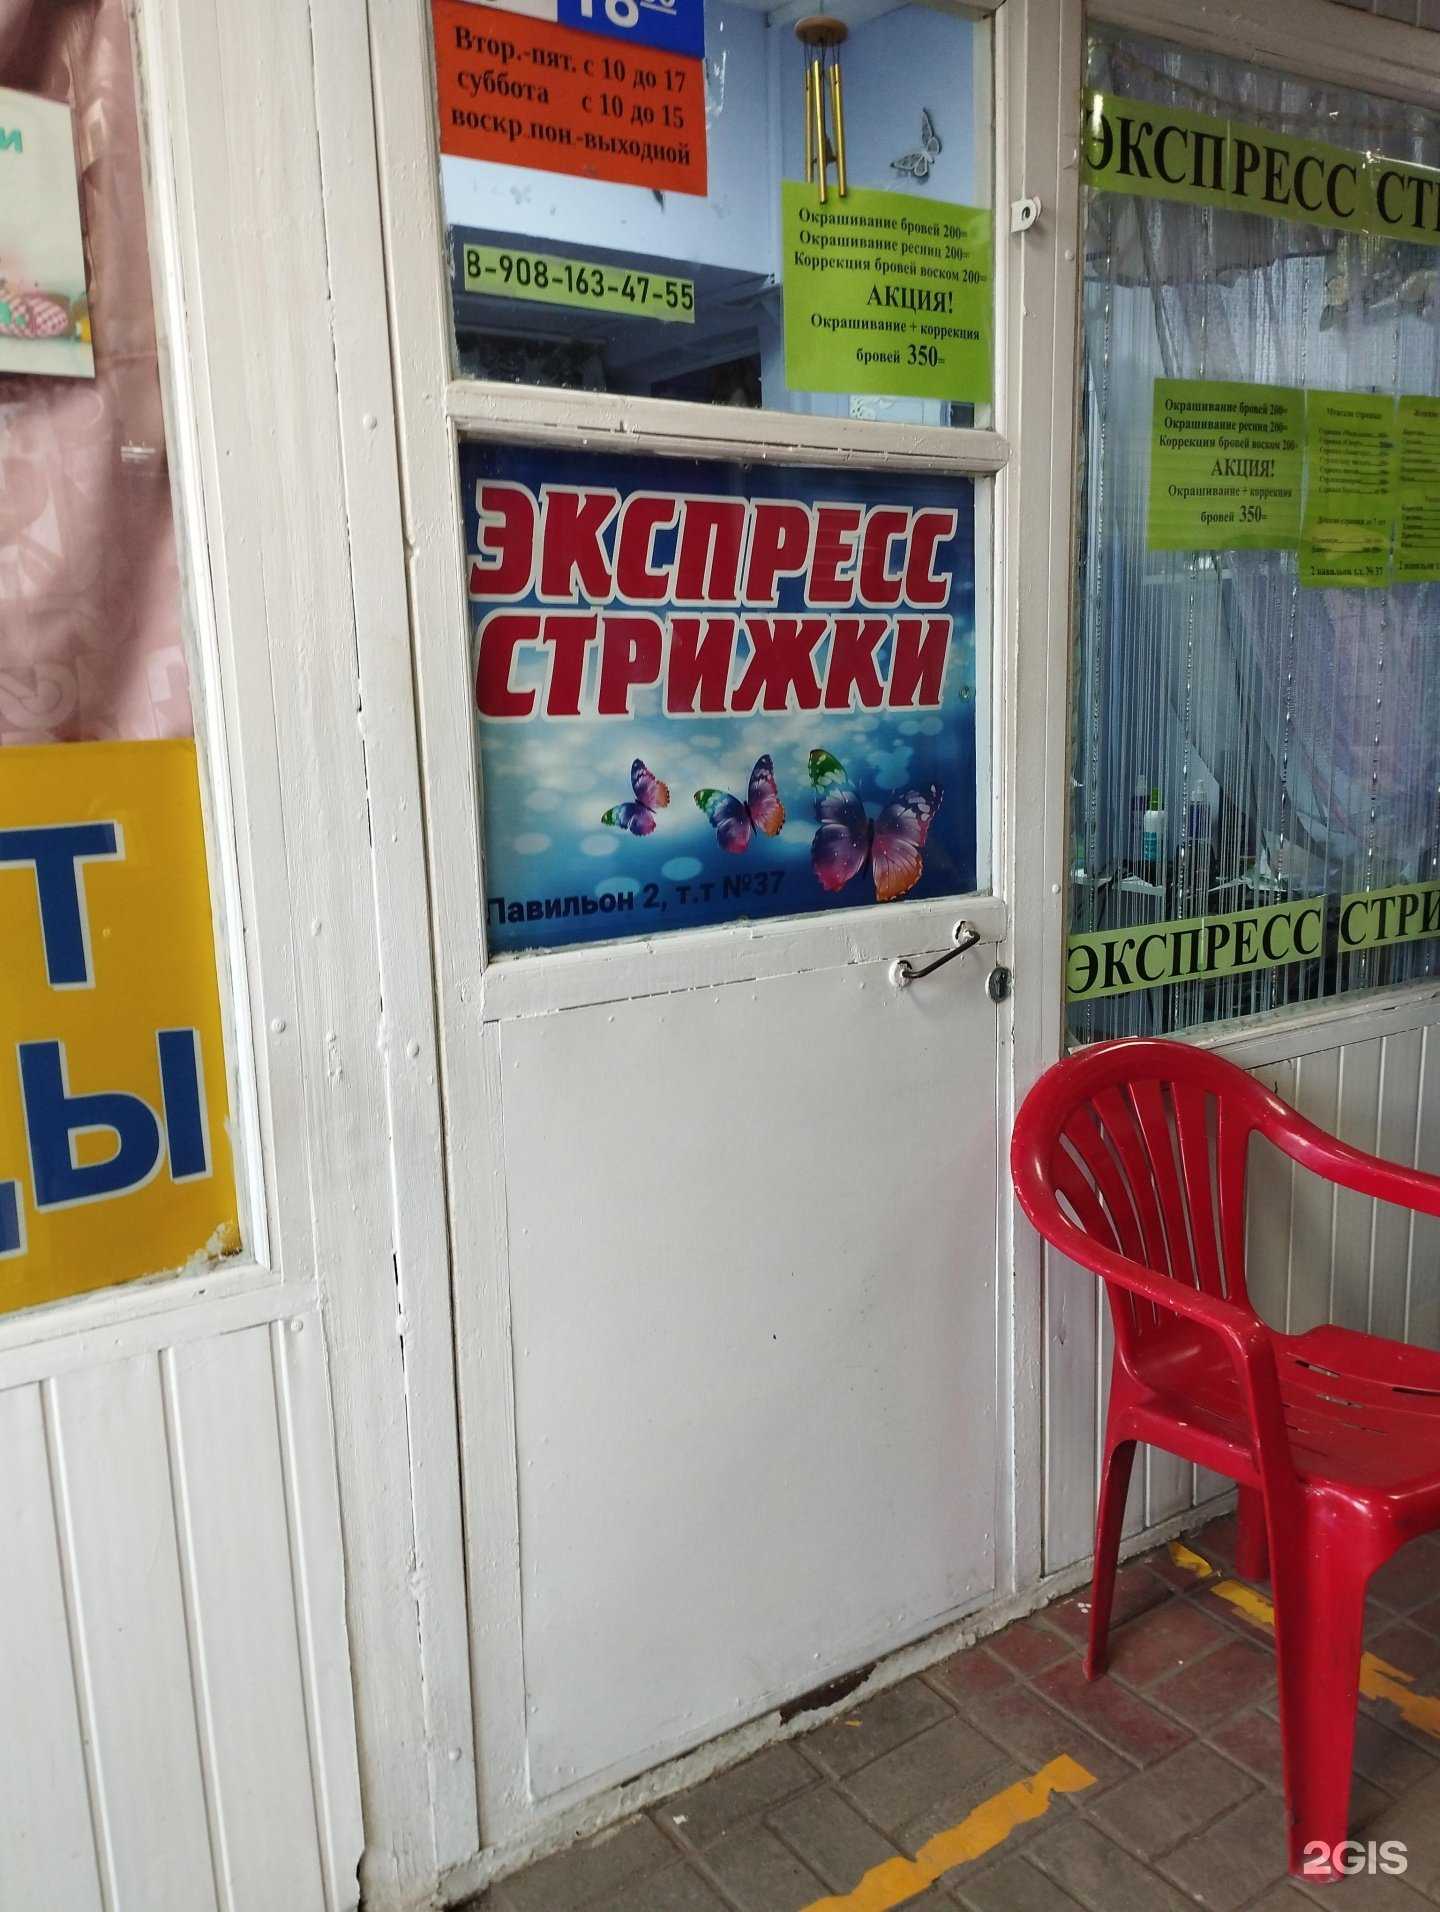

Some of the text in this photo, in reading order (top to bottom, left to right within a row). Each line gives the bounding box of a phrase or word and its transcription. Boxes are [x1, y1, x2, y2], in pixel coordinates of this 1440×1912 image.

[584, 59, 594, 77] с
[602, 58, 626, 83] 10
[633, 68, 657, 90] до
[664, 69, 686, 94] 17
[457, 69, 685, 129] суббота с 10 до 15
[1086, 110, 1440, 233] ЭКСПРЕСС СТ
[799, 208, 898, 229] Окрашивание
[901, 217, 940, 237] бровей
[800, 230, 898, 252] Окрашивание
[901, 242, 942, 258] ресниц
[466, 249, 694, 310] 8-908-163-47-55
[794, 251, 871, 271] Коррекция
[875, 257, 917, 276] бровей
[920, 267, 959, 281] воском
[867, 284, 954, 314] АКЦИЯ!
[811, 313, 907, 333] Окрашивание
[920, 325, 980, 342] коррекция
[856, 348, 901, 365] бровей
[1165, 398, 1237, 415] Окрашивание
[1164, 416, 1236, 432] Окрашивание
[1211, 459, 1275, 479] АКЦИЯ!
[1168, 484, 1241, 500] Окрашивание
[467, 480, 957, 607] ЭКСПРЕСС
[473, 607, 953, 722] СТРИЖКИ
[487, 889, 634, 925] Павильон
[643, 883, 668, 913] 2,
[723, 871, 785, 899] №37
[1068, 907, 1322, 994] ЭКСПРЕСС
